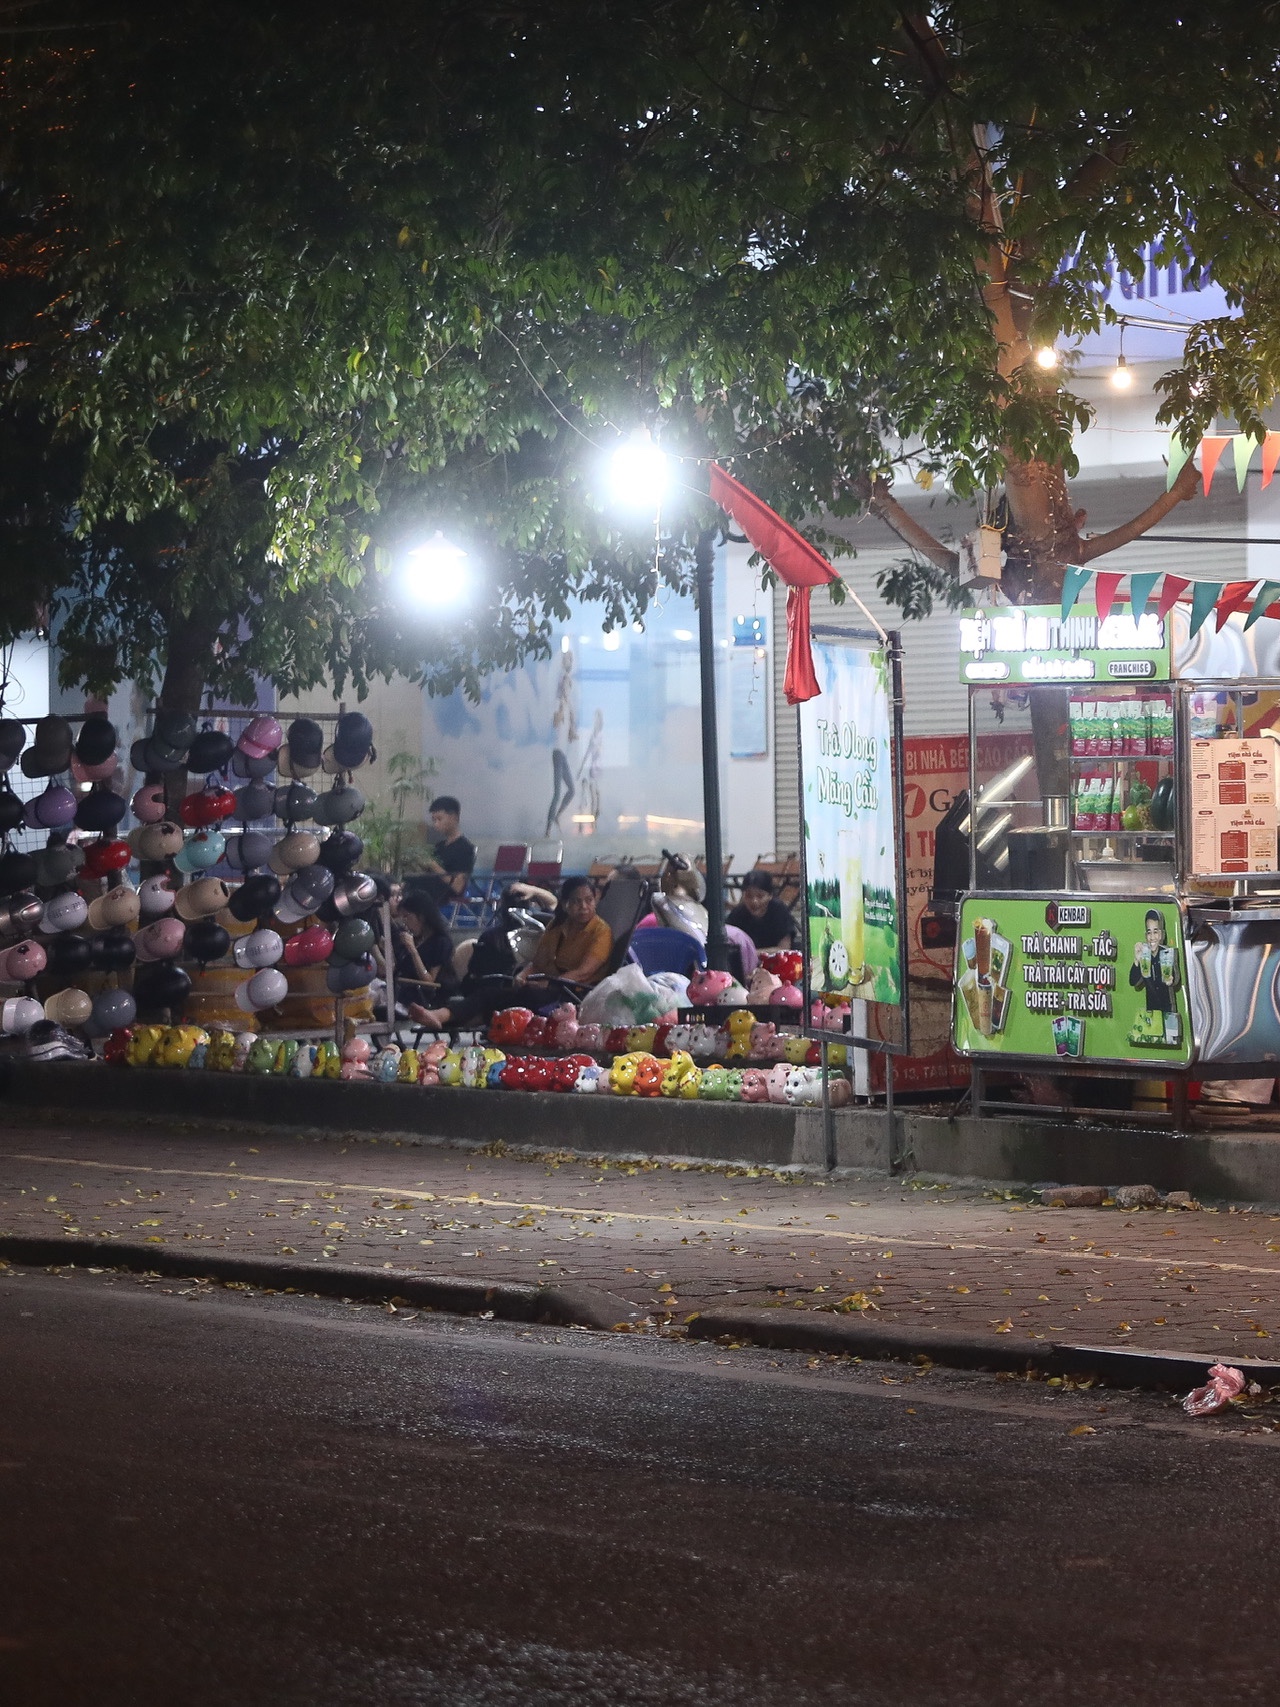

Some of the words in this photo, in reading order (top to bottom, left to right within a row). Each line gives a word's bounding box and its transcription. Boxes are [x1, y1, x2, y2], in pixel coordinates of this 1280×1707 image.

[1050, 616, 1097, 658] THỊNH
[1109, 663, 1150, 674] FRANCHISE
[817, 718, 842, 758] Trà
[842, 720, 878, 772] Olong
[920, 743, 947, 770] NHÀ
[817, 766, 853, 817] Măng
[853, 769, 879, 811] Cầu
[1060, 908, 1086, 922] KENBAR
[1021, 931, 1040, 954] TRÀ
[1043, 936, 1078, 954] CHANH
[1023, 962, 1042, 982] TRÀ
[1044, 962, 1065, 983] TRÁI
[1067, 962, 1085, 984] CÂY
[1087, 964, 1111, 985] TƯƠI
[1025, 991, 1059, 1009] COFFEE
[1067, 989, 1087, 1010] TRÀ
[1087, 990, 1108, 1011] SỮA
